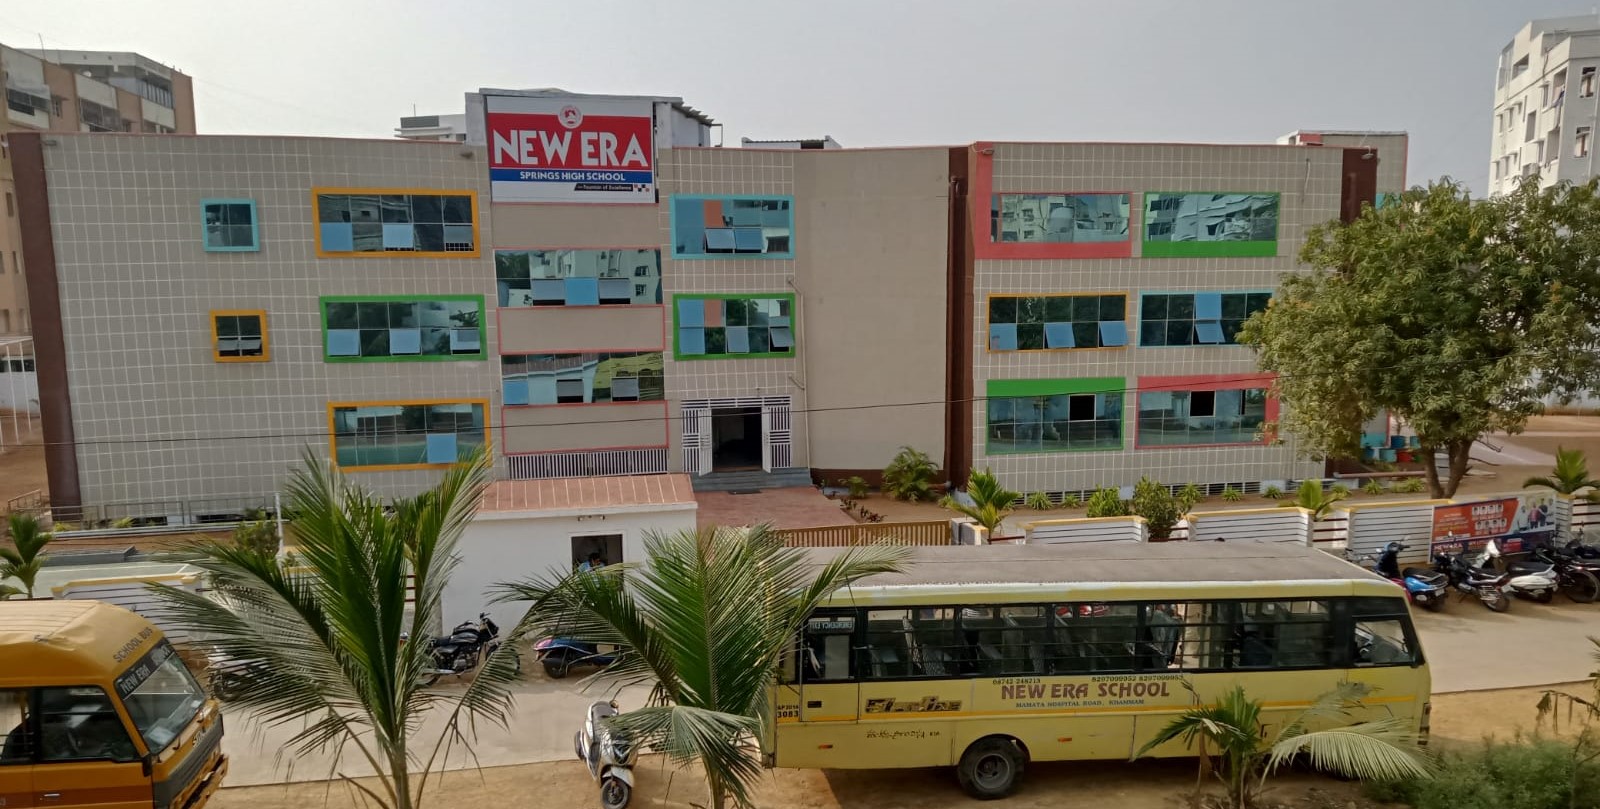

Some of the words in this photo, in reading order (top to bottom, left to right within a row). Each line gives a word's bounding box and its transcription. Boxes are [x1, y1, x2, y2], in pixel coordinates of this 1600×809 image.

[493, 129, 573, 166] NEW
[580, 131, 649, 167] ERA
[519, 171, 560, 180] SPRINGS
[561, 171, 585, 181] HIGH
[586, 172, 626, 181] SCHOOL
[113, 637, 143, 663] SCHOOL
[138, 626, 153, 640] BUS
[120, 673, 138, 694] NEW
[136, 664, 151, 680] ERA
[1001, 684, 1046, 700] NEW
[1051, 683, 1089, 699] ERA
[1097, 682, 1170, 699] SCHOOL
